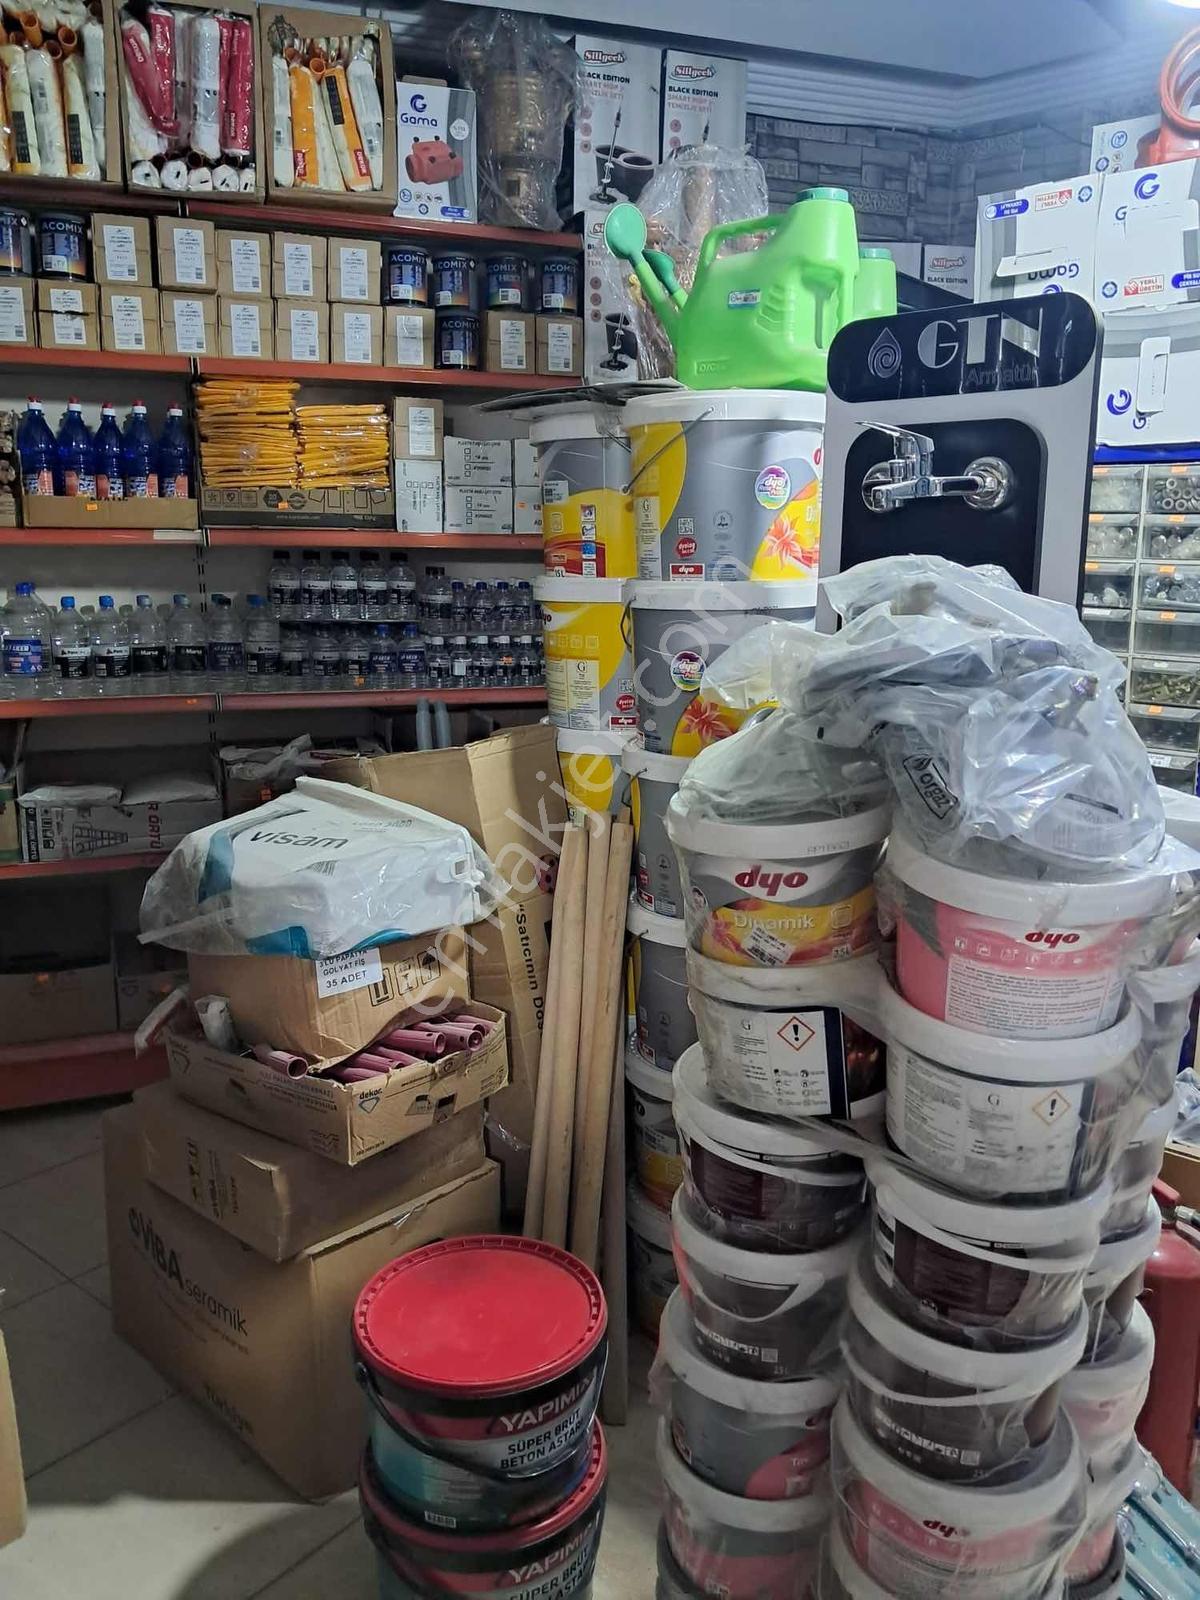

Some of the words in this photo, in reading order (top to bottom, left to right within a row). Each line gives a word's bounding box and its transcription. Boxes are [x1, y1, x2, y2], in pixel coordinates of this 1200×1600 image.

[603, 74, 630, 83] EDITION
[668, 86, 690, 94] BLACK
[692, 88, 719, 98] EDITION
[400, 113, 438, 127] Gama
[42, 221, 83, 234] ACOMIX
[917, 307, 1043, 369] GTN
[765, 476, 785, 487] dyo
[678, 566, 695, 574] dyo
[919, 773, 952, 809] orgaz
[250, 831, 349, 849] visam
[735, 864, 808, 896] dyo
[734, 911, 815, 929] Dinamik
[326, 979, 338, 989] 35
[340, 970, 368, 985] ADET
[185, 1280, 248, 1337] seramik
[508, 1431, 552, 1456] SÜPER
[501, 1446, 546, 1470] BETON
